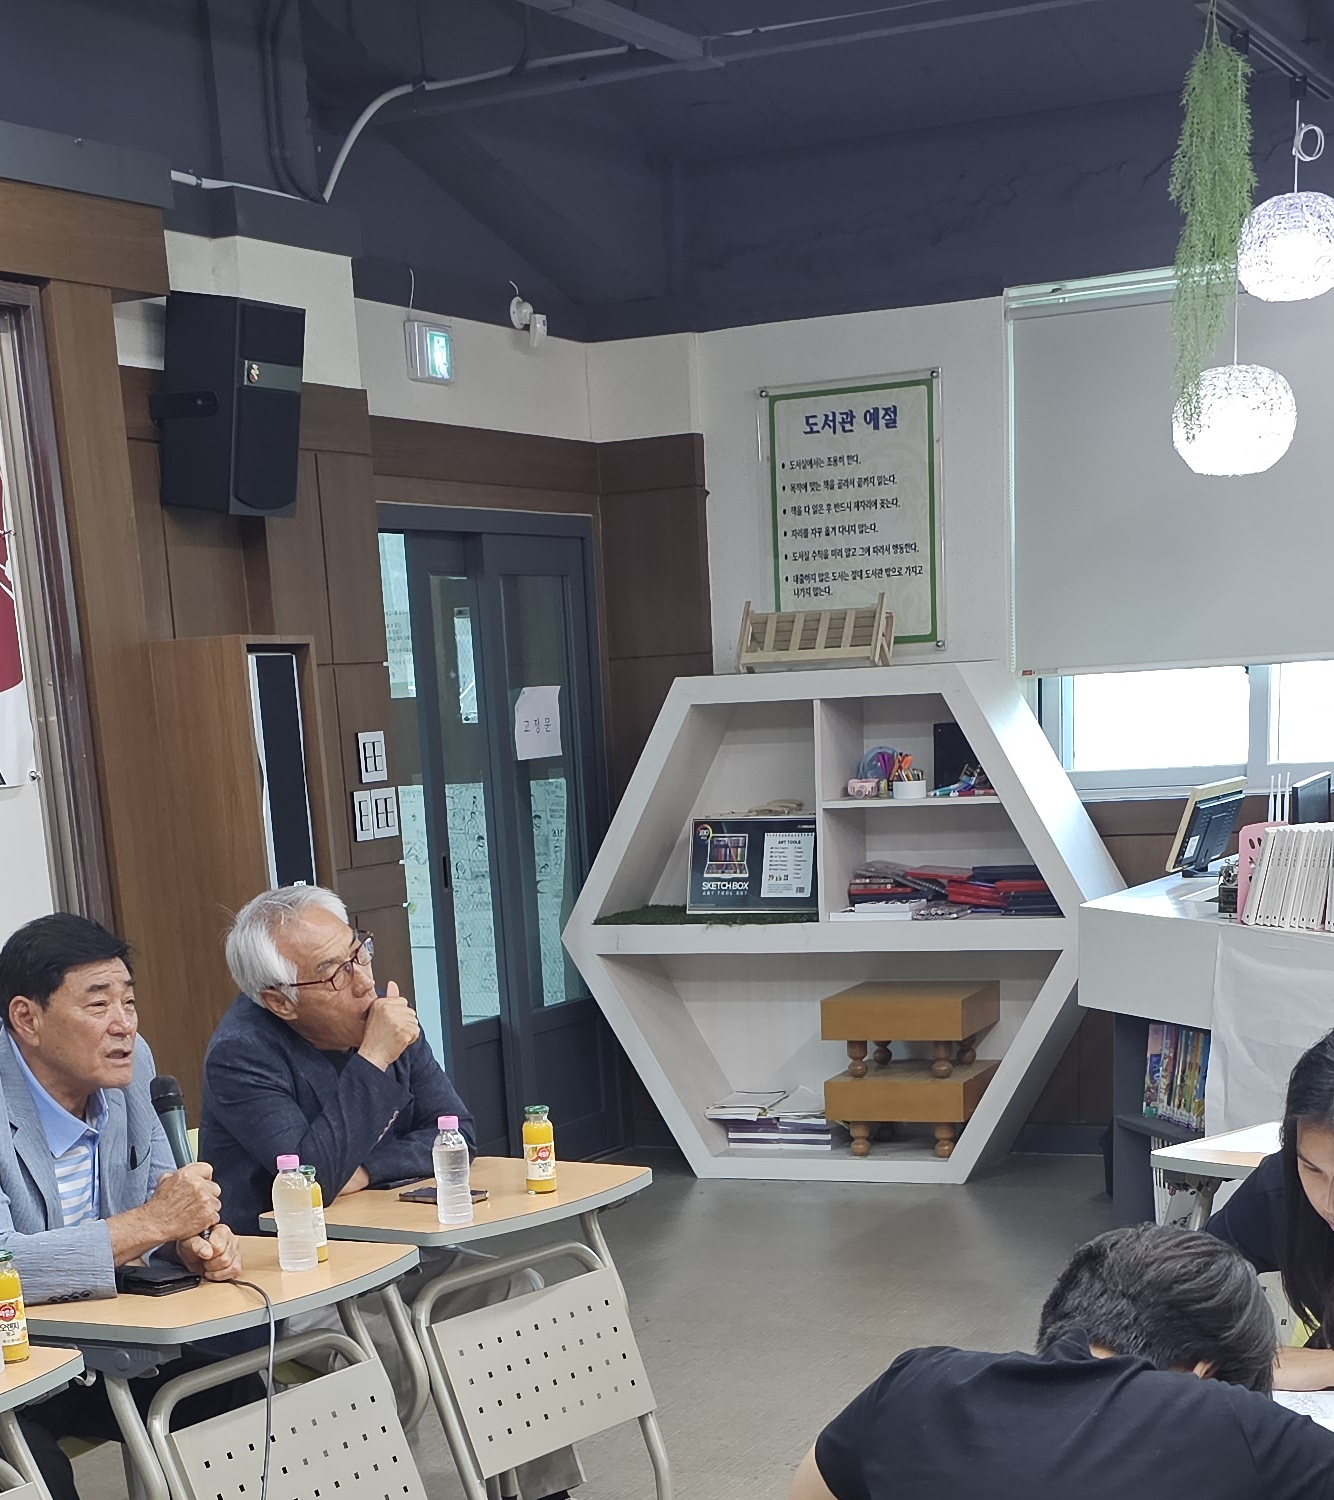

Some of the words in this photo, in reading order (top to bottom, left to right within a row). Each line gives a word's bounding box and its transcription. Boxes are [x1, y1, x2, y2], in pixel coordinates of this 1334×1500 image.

[803, 409, 856, 435] 도서관
[863, 404, 898, 431] 예절
[826, 455, 845, 467] 조용히
[823, 480, 835, 491] 책을
[791, 506, 802, 516] 책을
[804, 506, 810, 515] 다
[826, 503, 832, 514] 후
[834, 501, 852, 512] 반드시
[838, 524, 856, 536] 다니지
[792, 551, 809, 562] 도서실
[832, 571, 849, 581] 도서는
[851, 569, 863, 580] 절대
[865, 568, 883, 578] 도서관
[905, 565, 923, 576] 가지고
[793, 587, 811, 598] 나가지
[523, 717, 552, 734] 고정문
